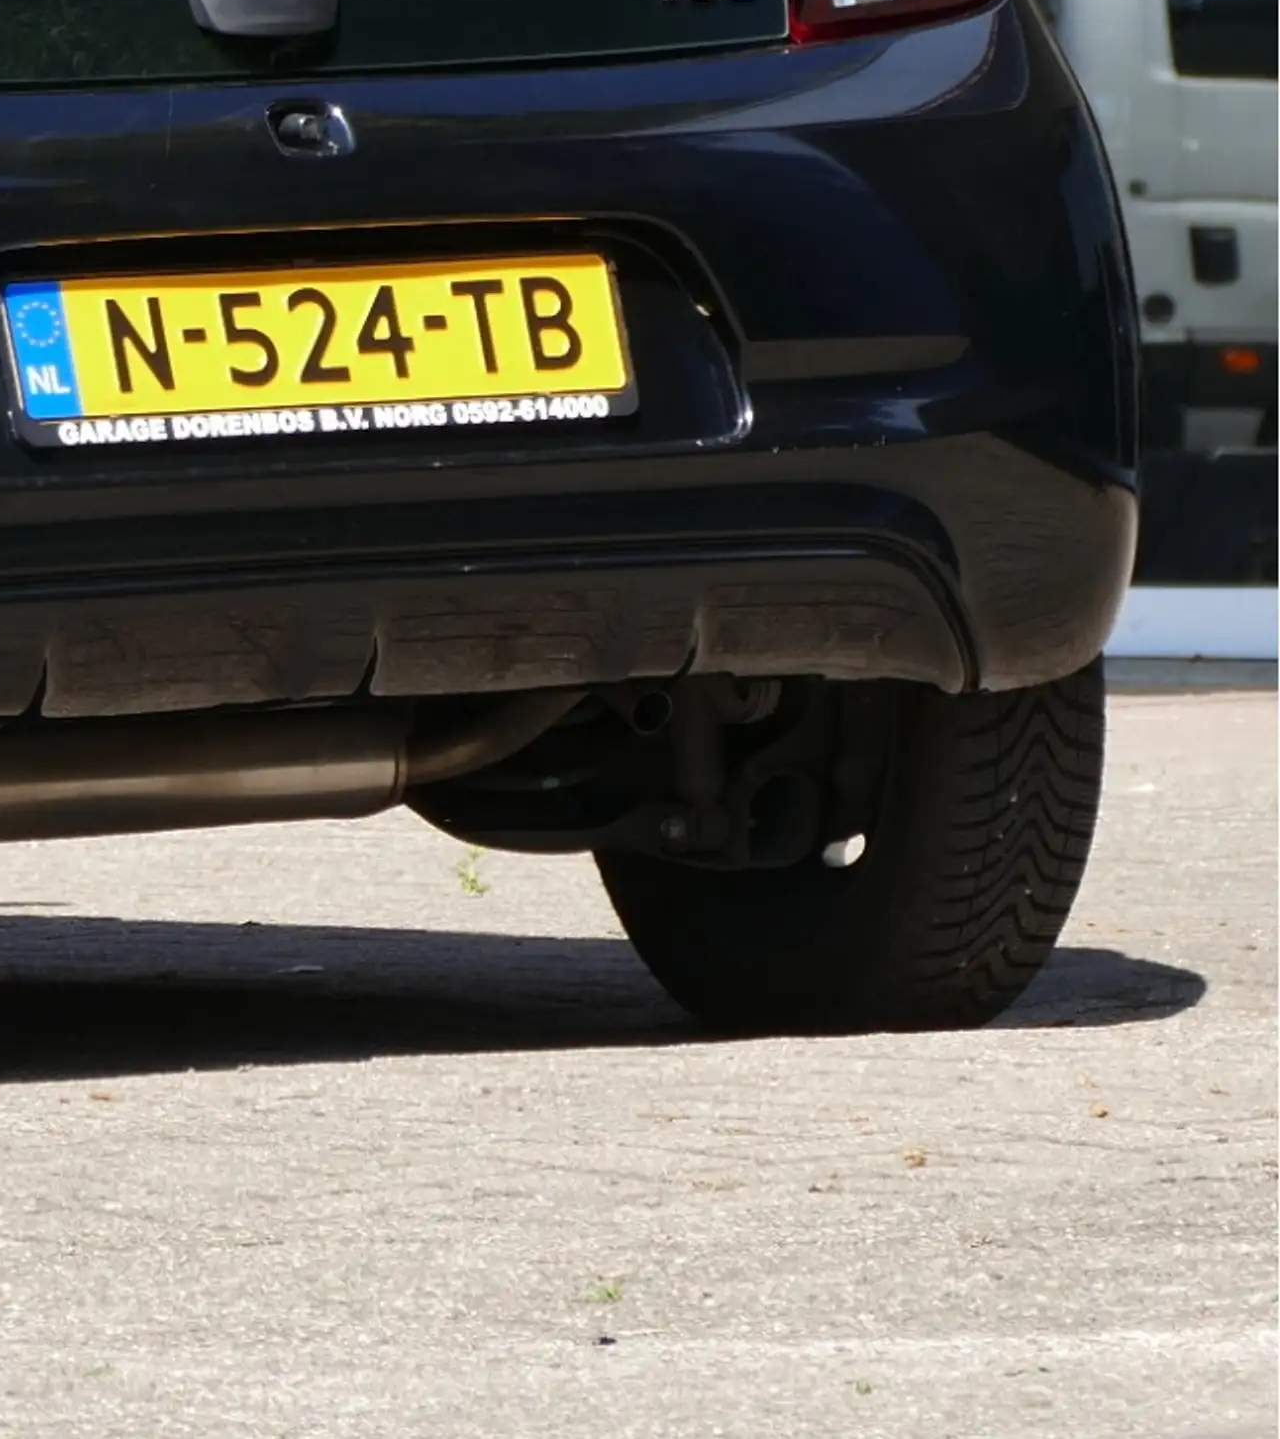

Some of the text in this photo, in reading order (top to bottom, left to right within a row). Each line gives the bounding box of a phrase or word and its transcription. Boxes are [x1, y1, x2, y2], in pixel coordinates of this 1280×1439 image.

[104, 275, 584, 394] N-524-TB
[25, 364, 71, 396] NL
[57, 395, 610, 446] GARAGE DORENBOS B.V. NORG 0592-614000
